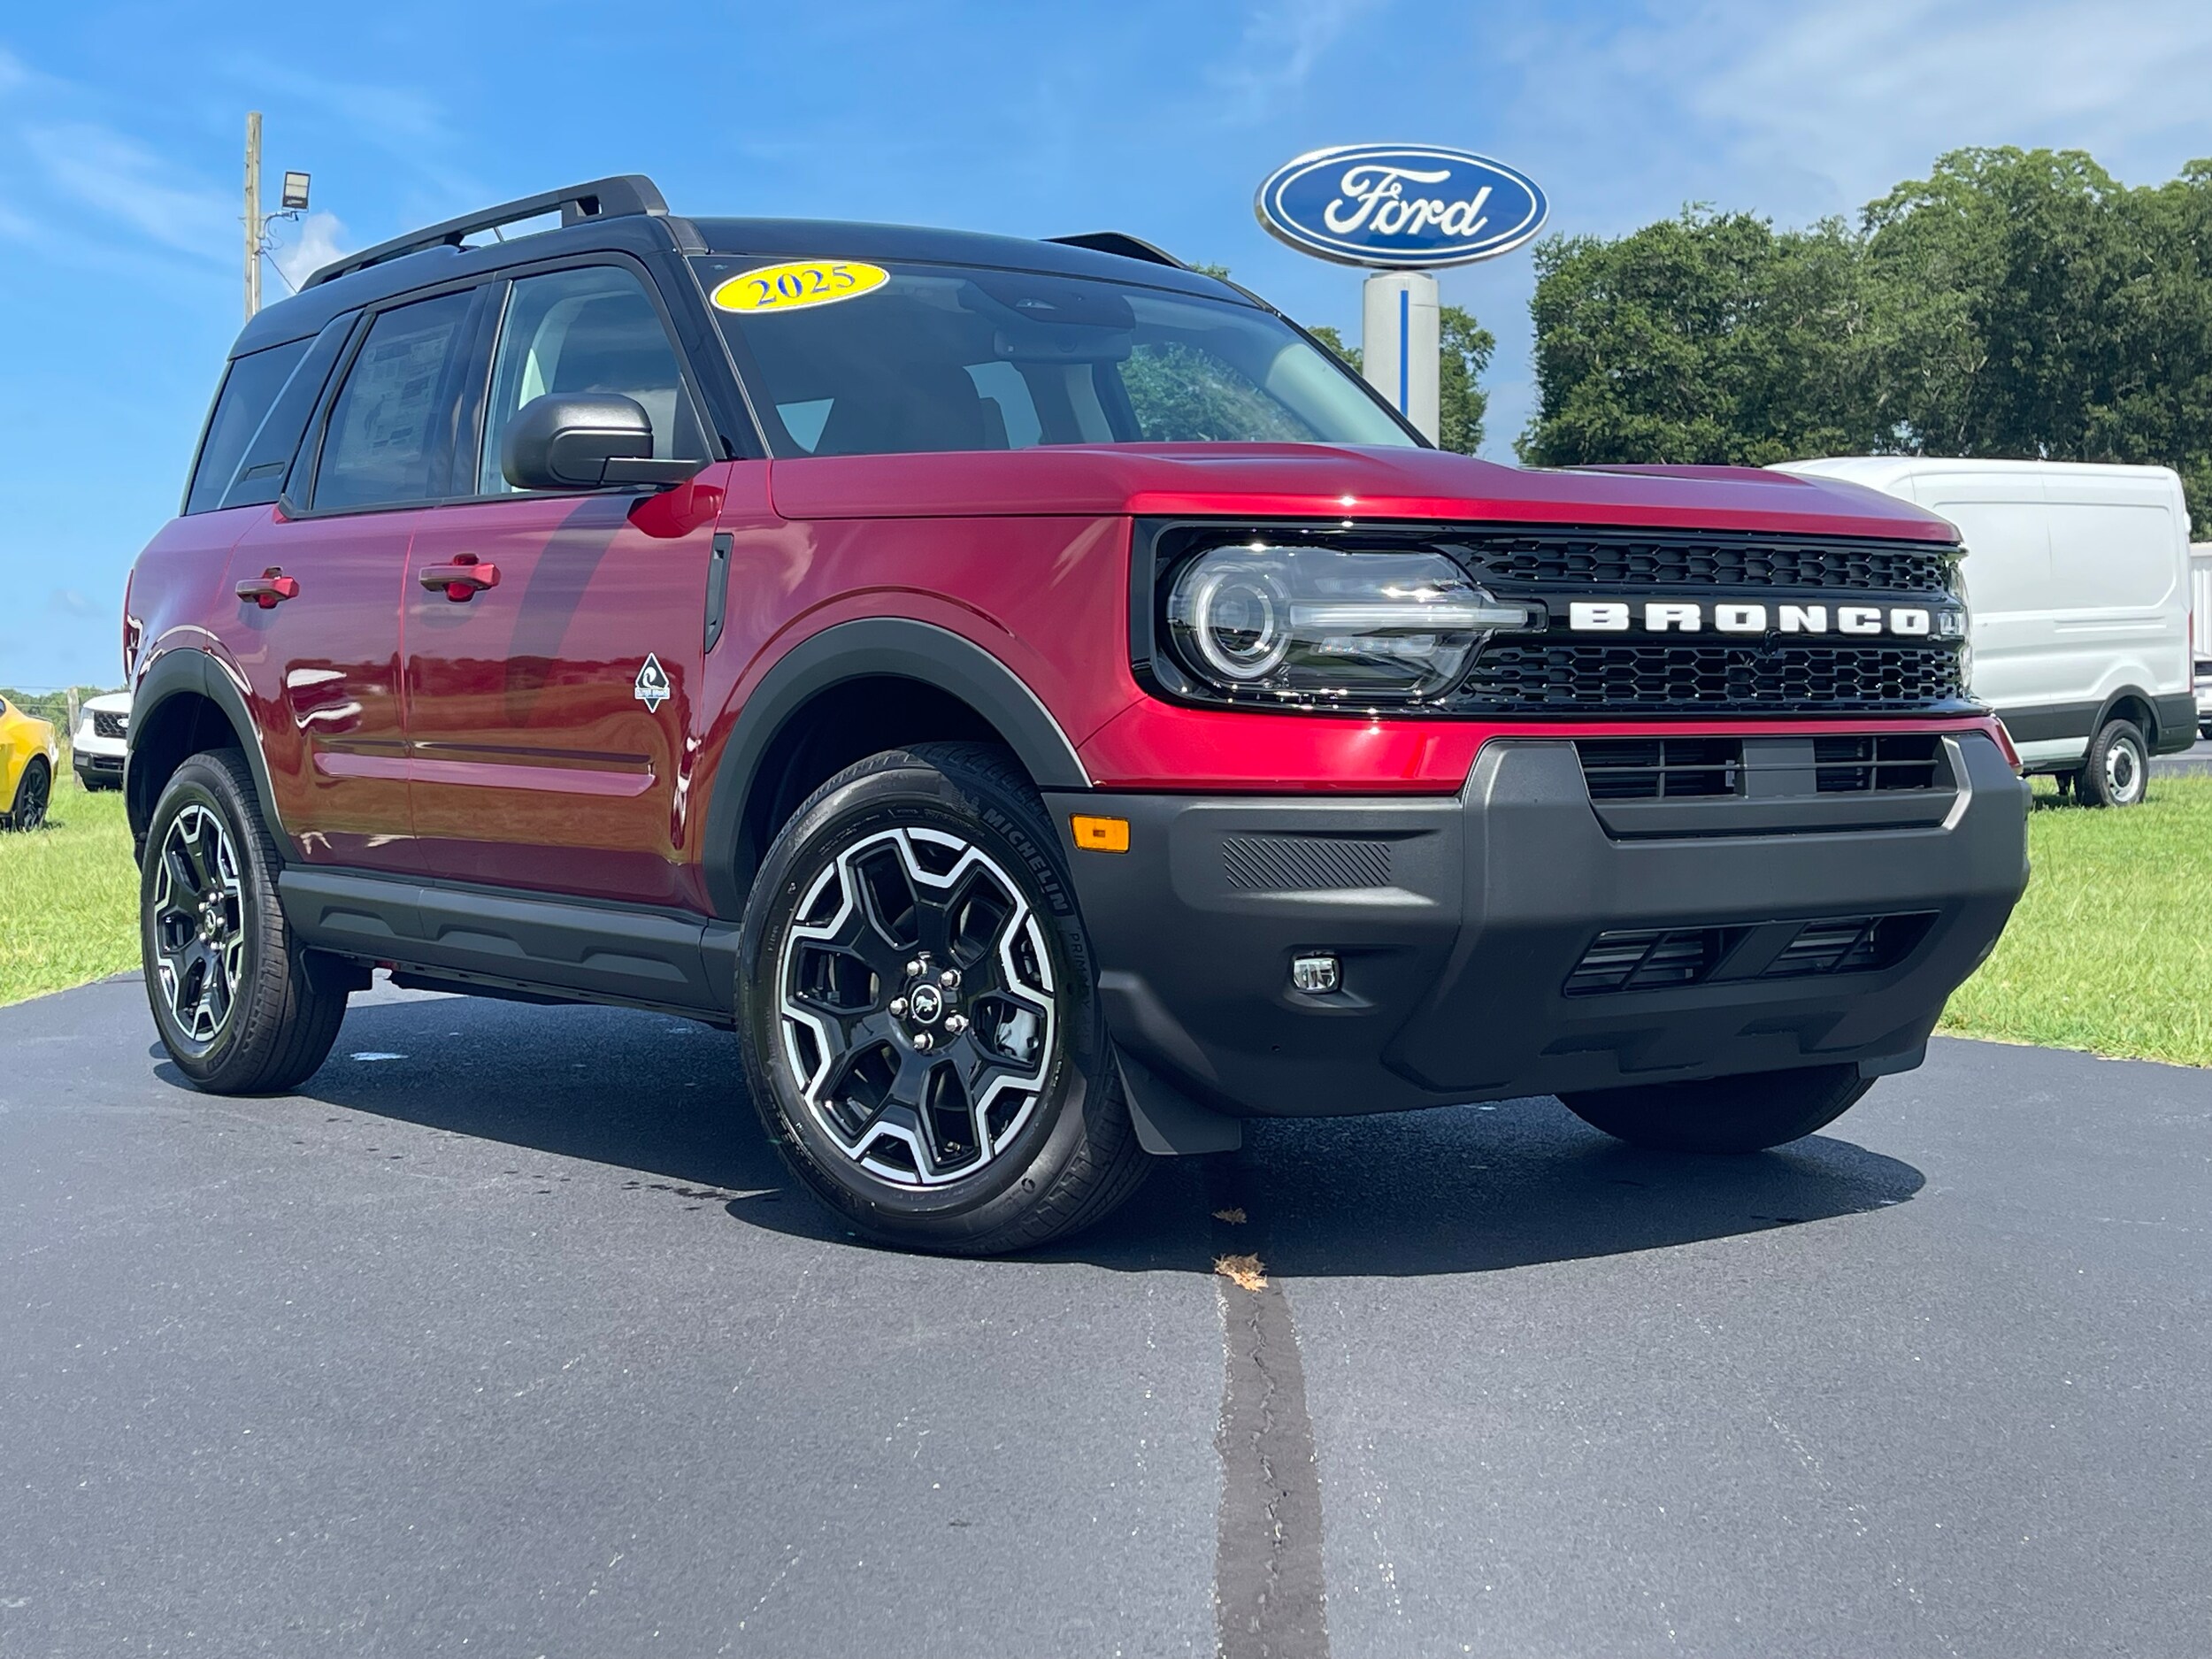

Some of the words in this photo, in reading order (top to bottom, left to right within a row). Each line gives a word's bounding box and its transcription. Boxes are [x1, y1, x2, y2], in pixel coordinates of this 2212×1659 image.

[1324, 165, 1493, 236] Ford
[748, 265, 856, 306] 2025
[1569, 602, 1930, 634] BRONCO
[983, 808, 1069, 911] MICHELIN
